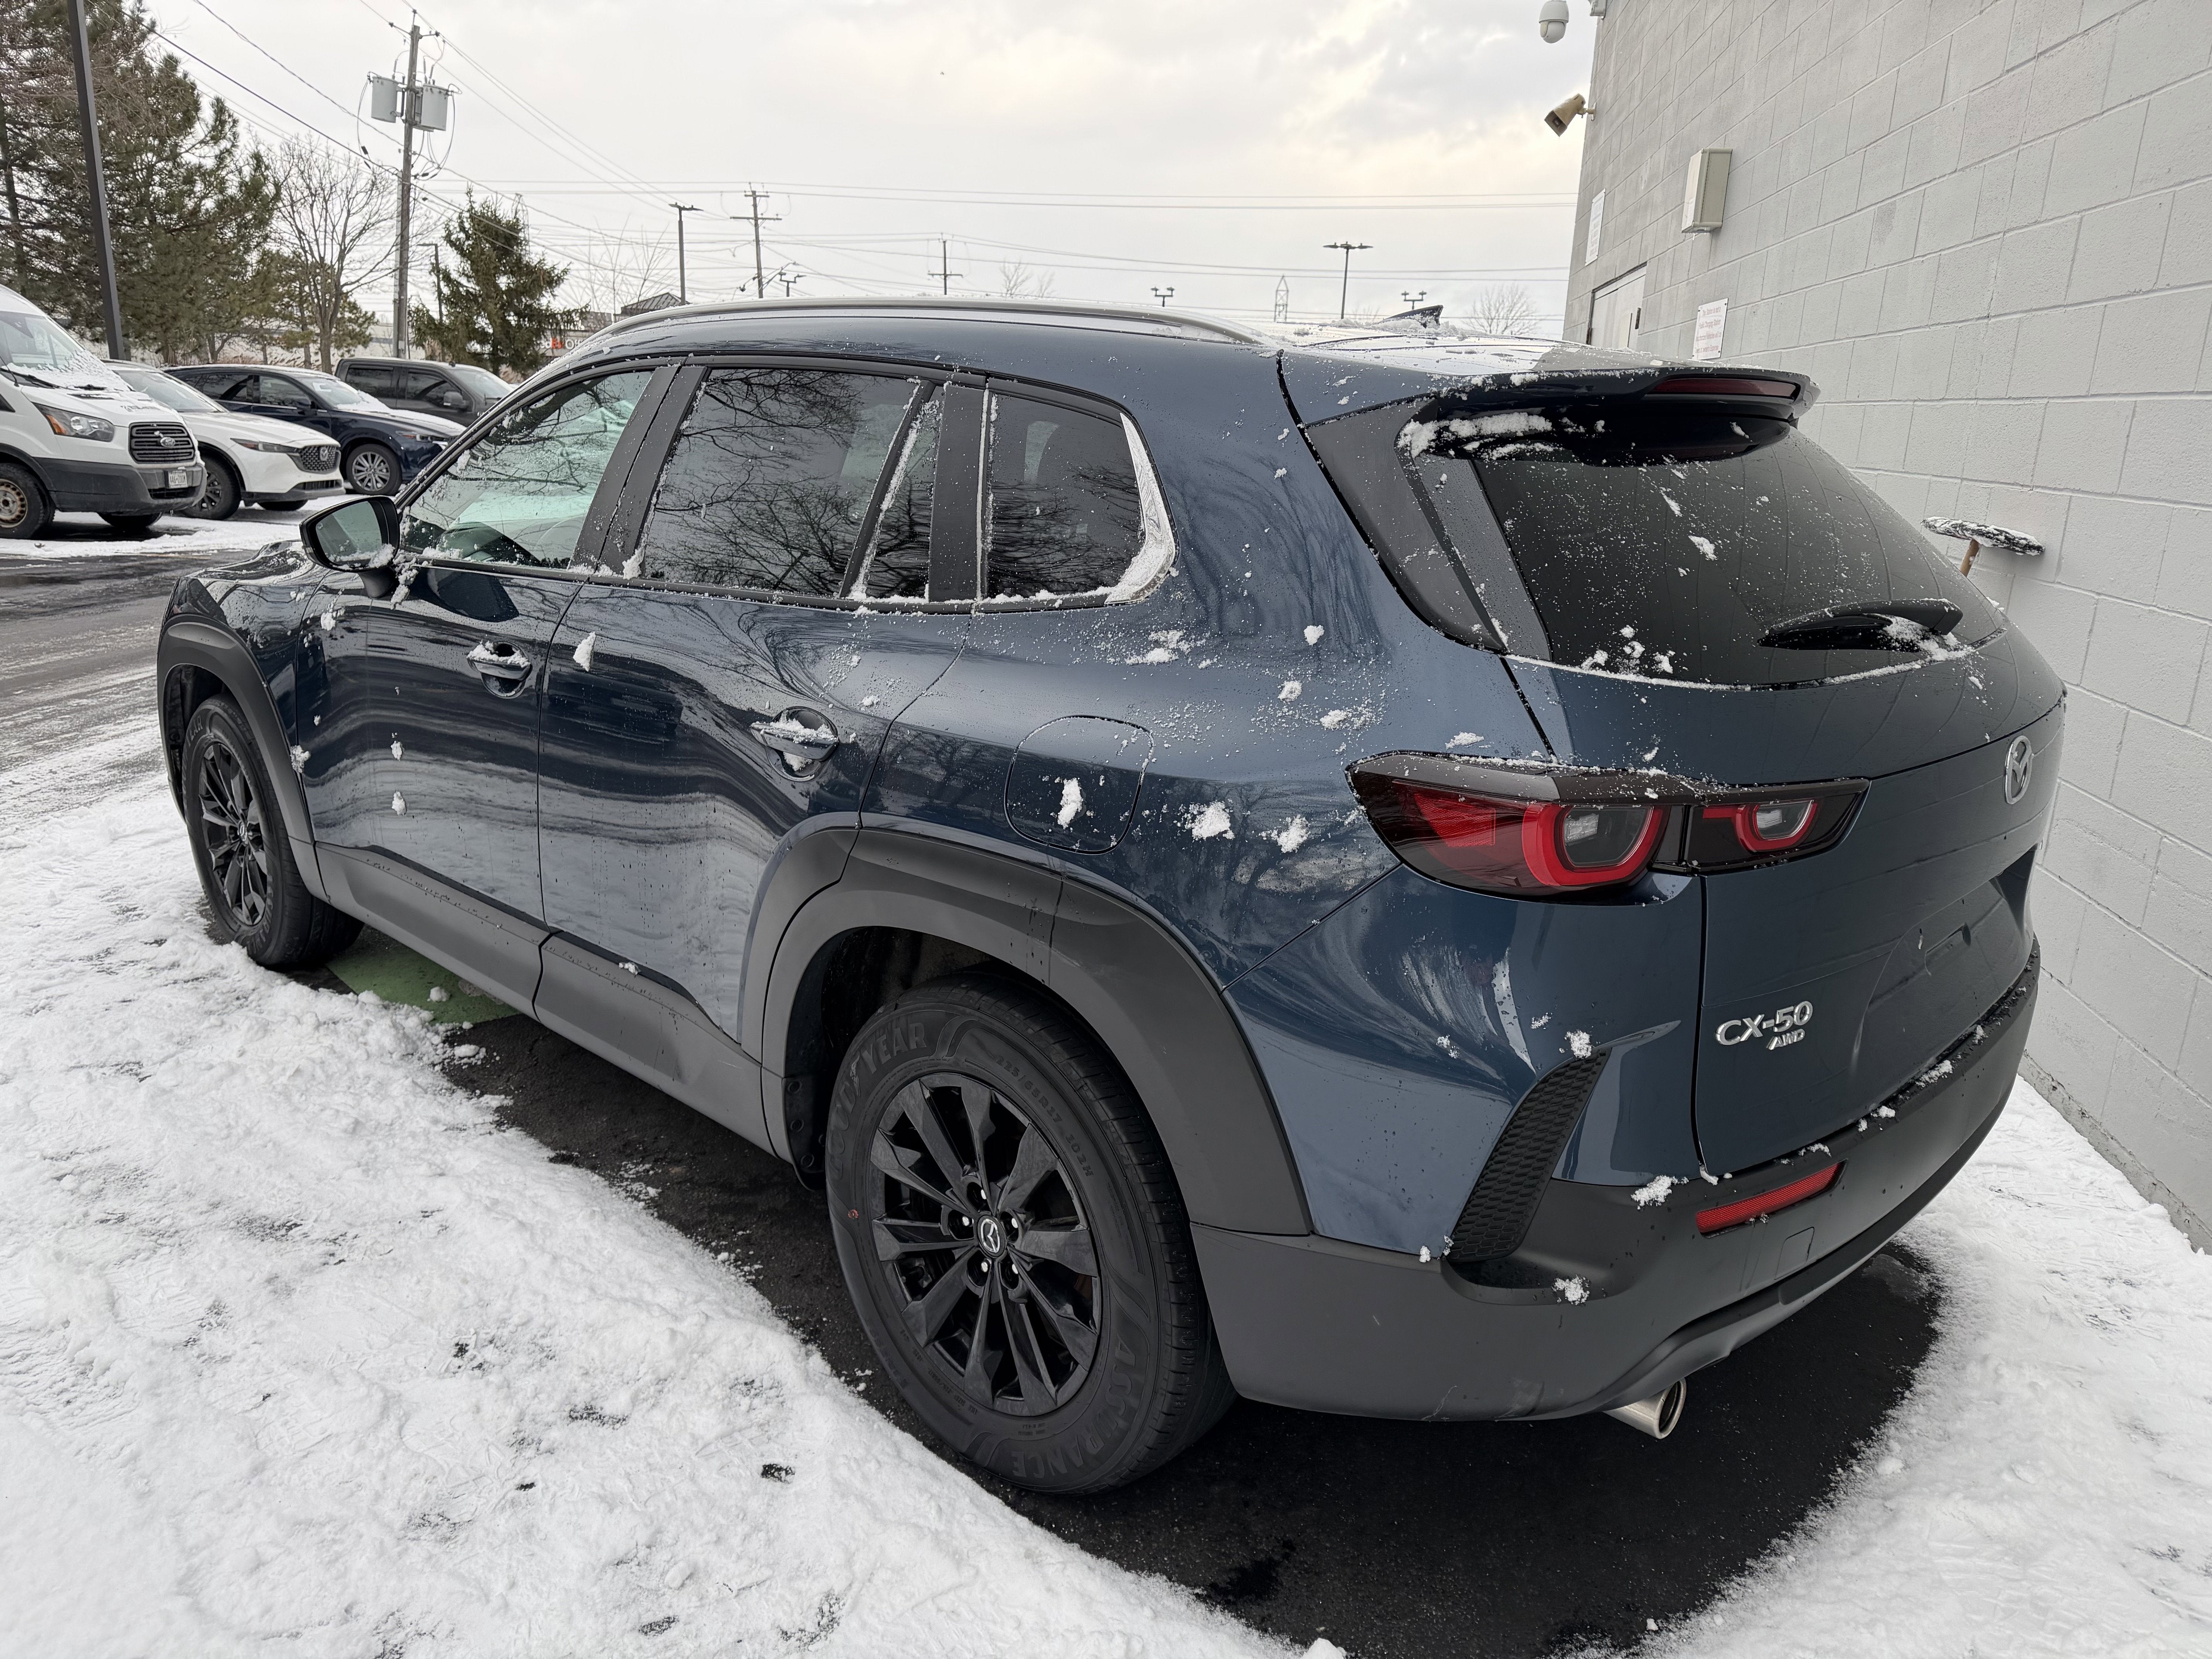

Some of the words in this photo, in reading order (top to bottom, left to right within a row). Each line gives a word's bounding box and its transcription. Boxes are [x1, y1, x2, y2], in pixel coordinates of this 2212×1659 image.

[1715, 1000, 1814, 1046] CX-50
[1766, 1028, 1806, 1050] AWD
[828, 1022, 927, 1180] GOODYEAR
[1012, 1332, 1136, 1479] ASSURANCE
